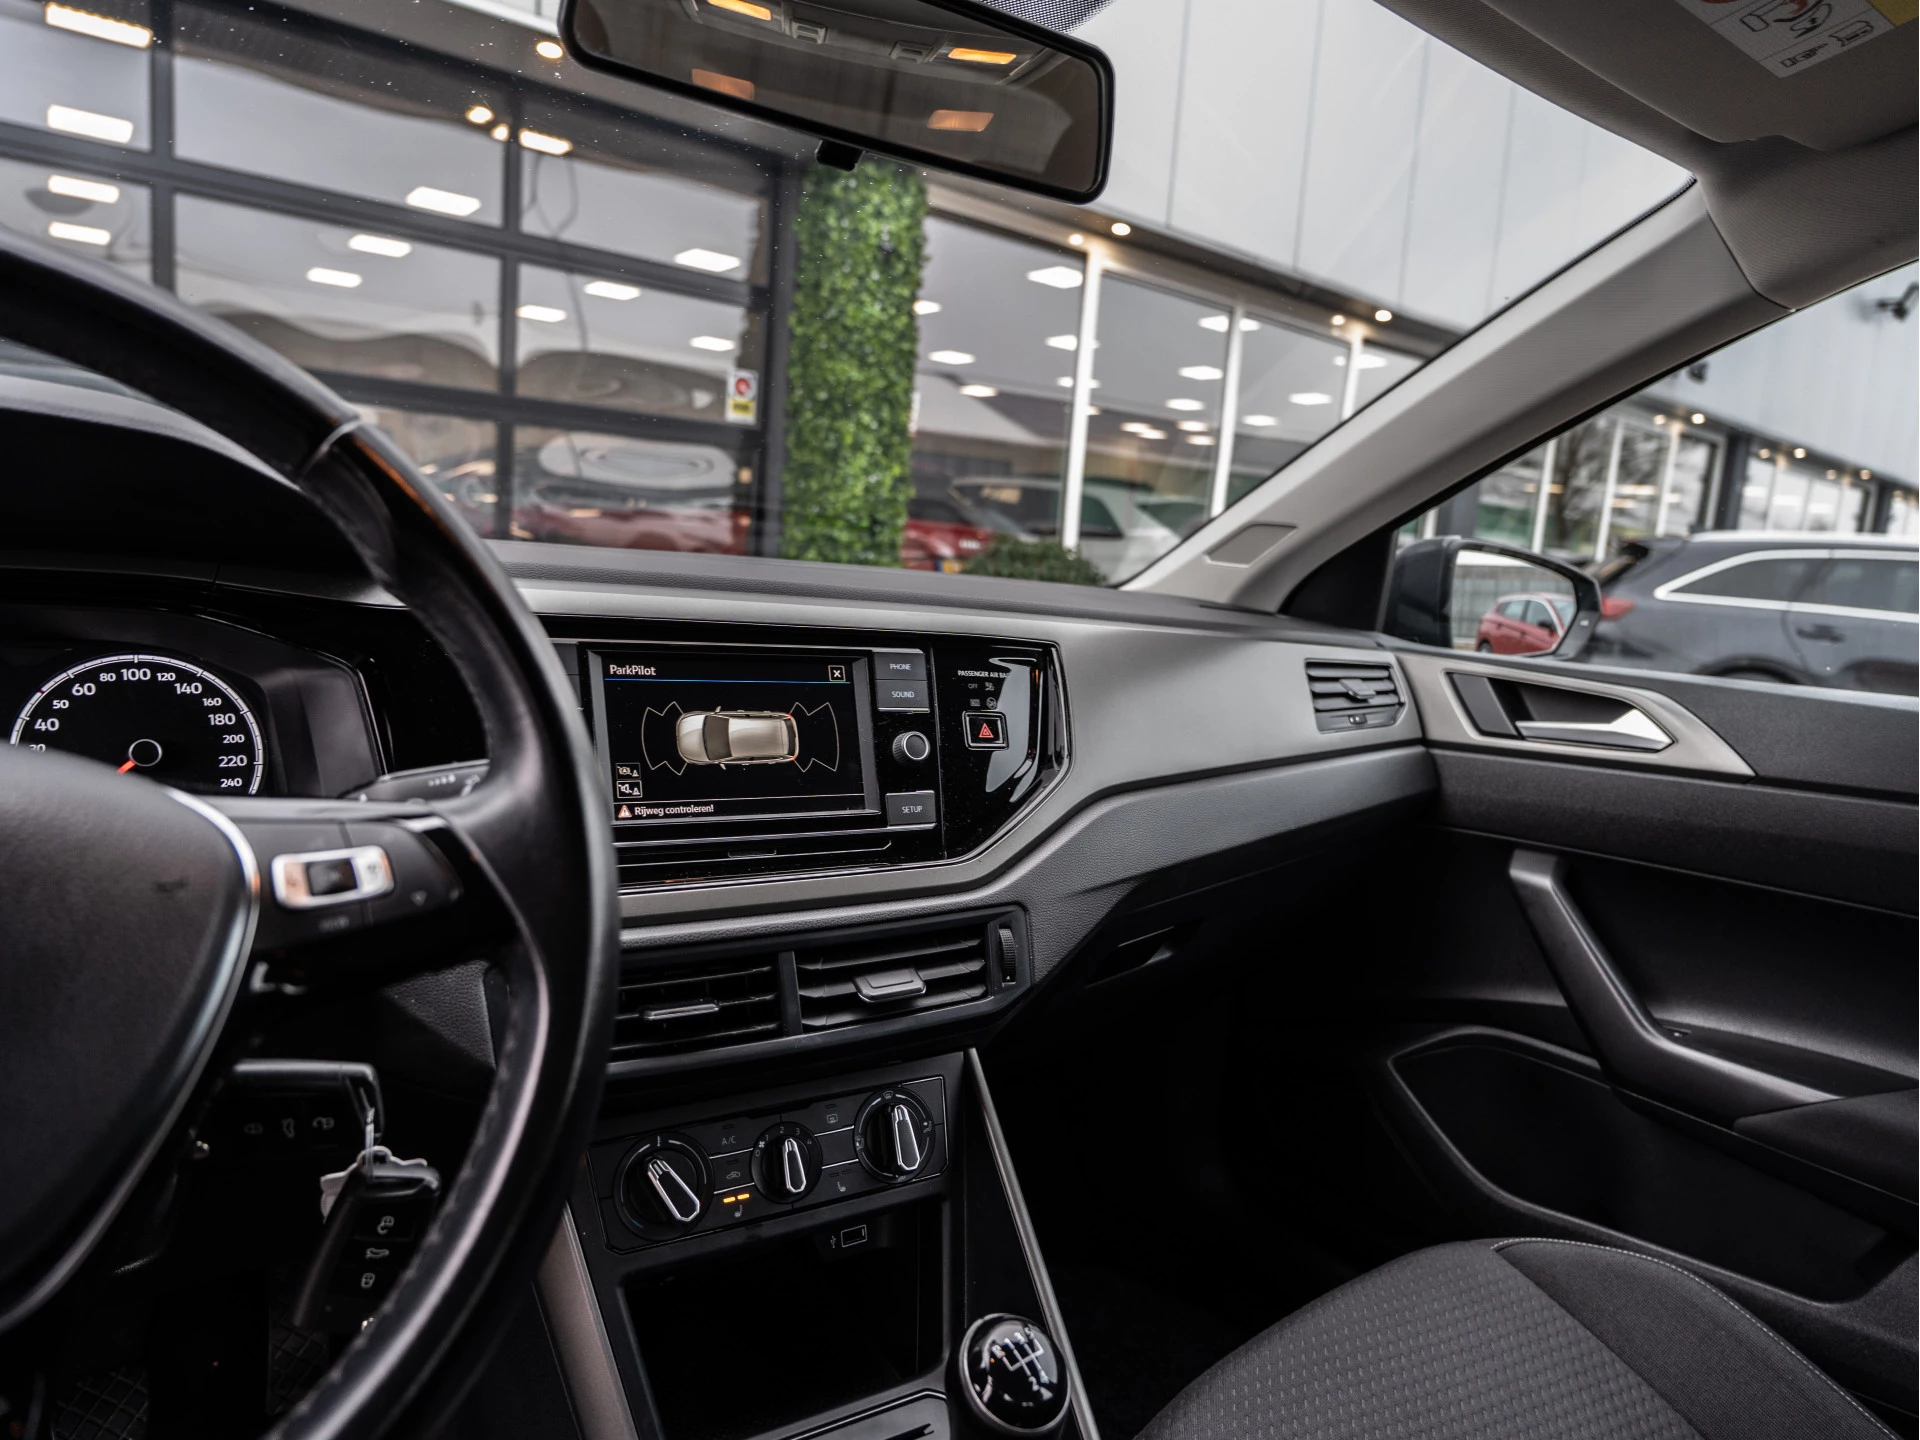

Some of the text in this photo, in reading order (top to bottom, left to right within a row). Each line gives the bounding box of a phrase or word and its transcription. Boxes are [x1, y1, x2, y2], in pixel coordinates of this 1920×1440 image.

[609, 664, 657, 676] ParkPilot
[889, 663, 912, 671] PHONE
[99, 672, 117, 682] 80
[120, 668, 152, 681] 100
[156, 672, 176, 682] 120
[957, 669, 989, 678] PASSENGER
[71, 682, 97, 697] 60
[174, 682, 203, 695] 140
[891, 690, 915, 698] SOUND
[52, 699, 70, 710] 50
[201, 697, 222, 707] 160
[34, 717, 60, 732] 40
[207, 712, 236, 726] 180
[222, 733, 245, 744] 200
[218, 754, 248, 768] 220
[220, 777, 243, 788] 240
[634, 804, 715, 817] Rijweg controleren!
[901, 805, 923, 815] SETUP
[779, 1126, 786, 1134] 2
[721, 1135, 736, 1146] A/C
